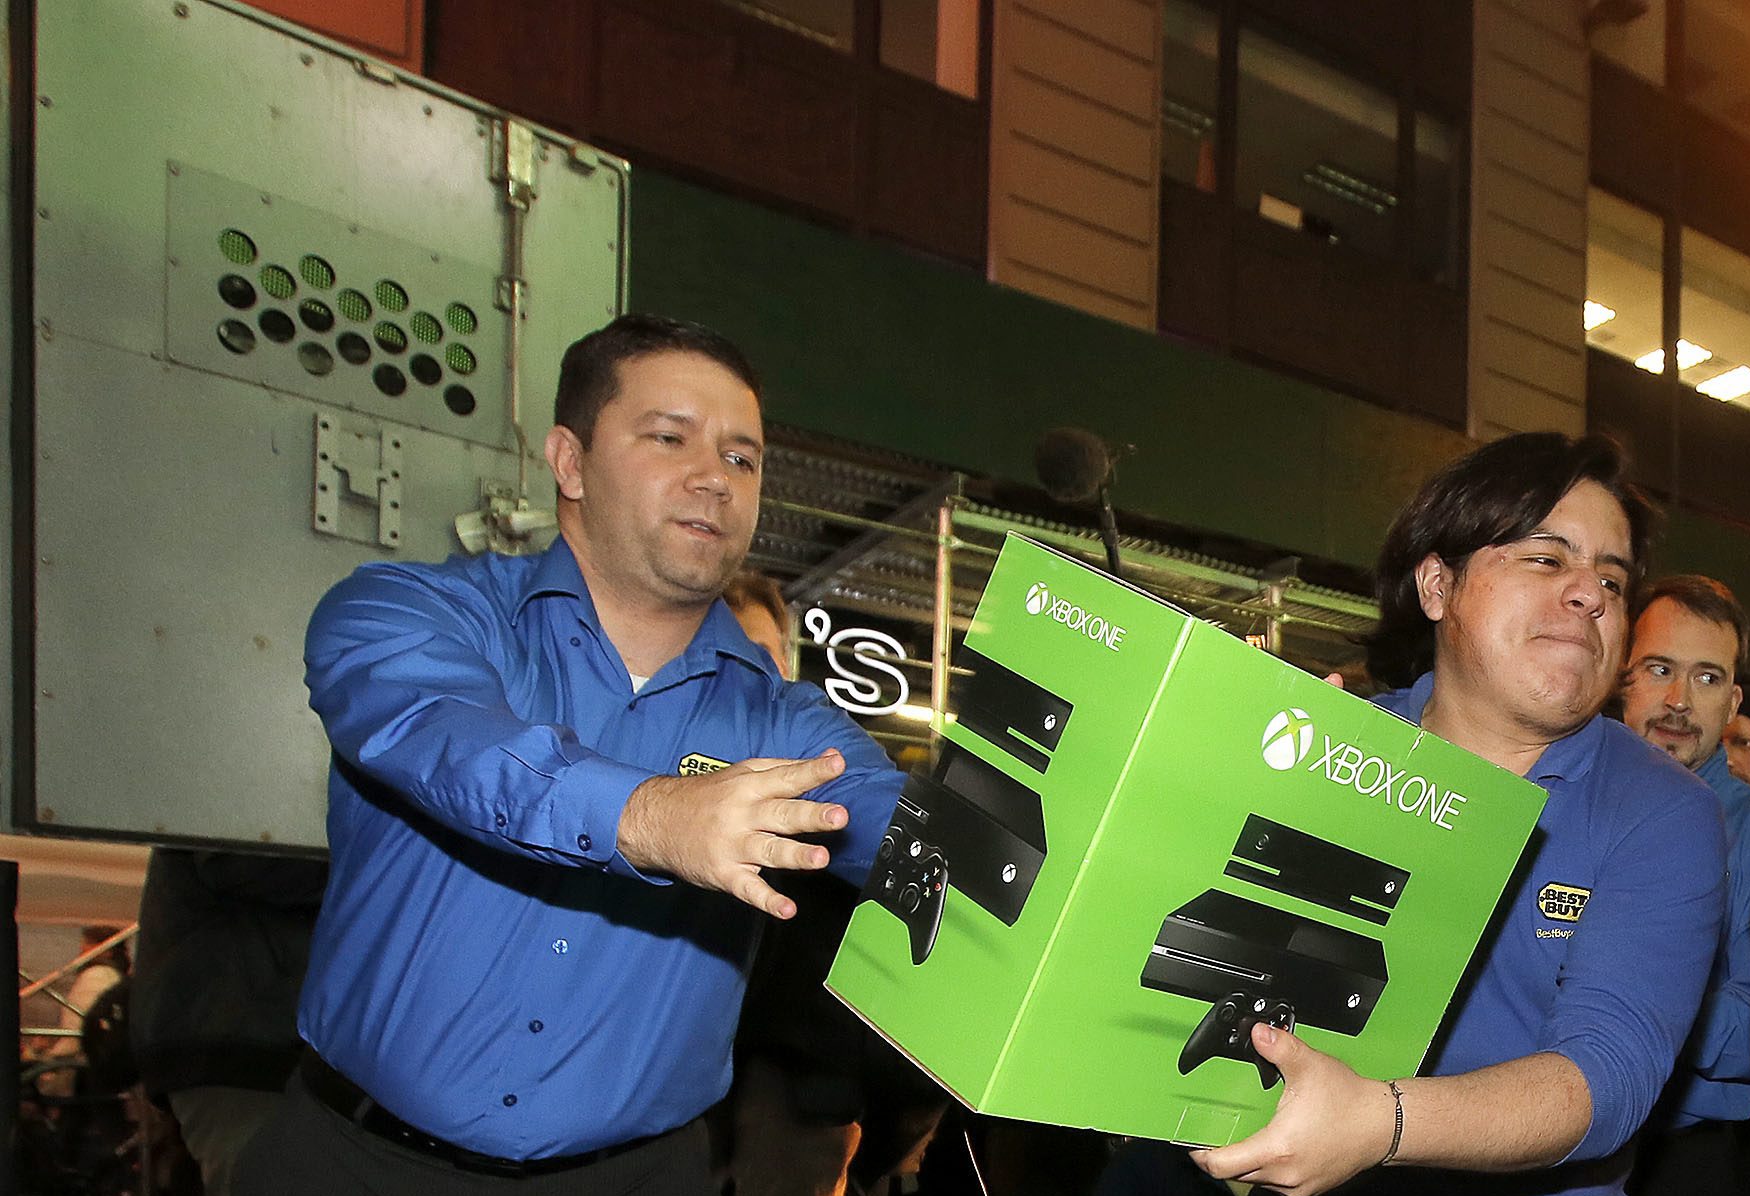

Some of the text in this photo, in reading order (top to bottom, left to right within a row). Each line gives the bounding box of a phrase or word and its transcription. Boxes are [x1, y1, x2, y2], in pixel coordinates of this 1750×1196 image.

[1045, 595, 1127, 652] XBOX ONE
[687, 758, 721, 773] BES
[1307, 734, 1469, 831] XBOX ONE
[1545, 888, 1588, 906] BEST
[1544, 901, 1583, 918] BUY
